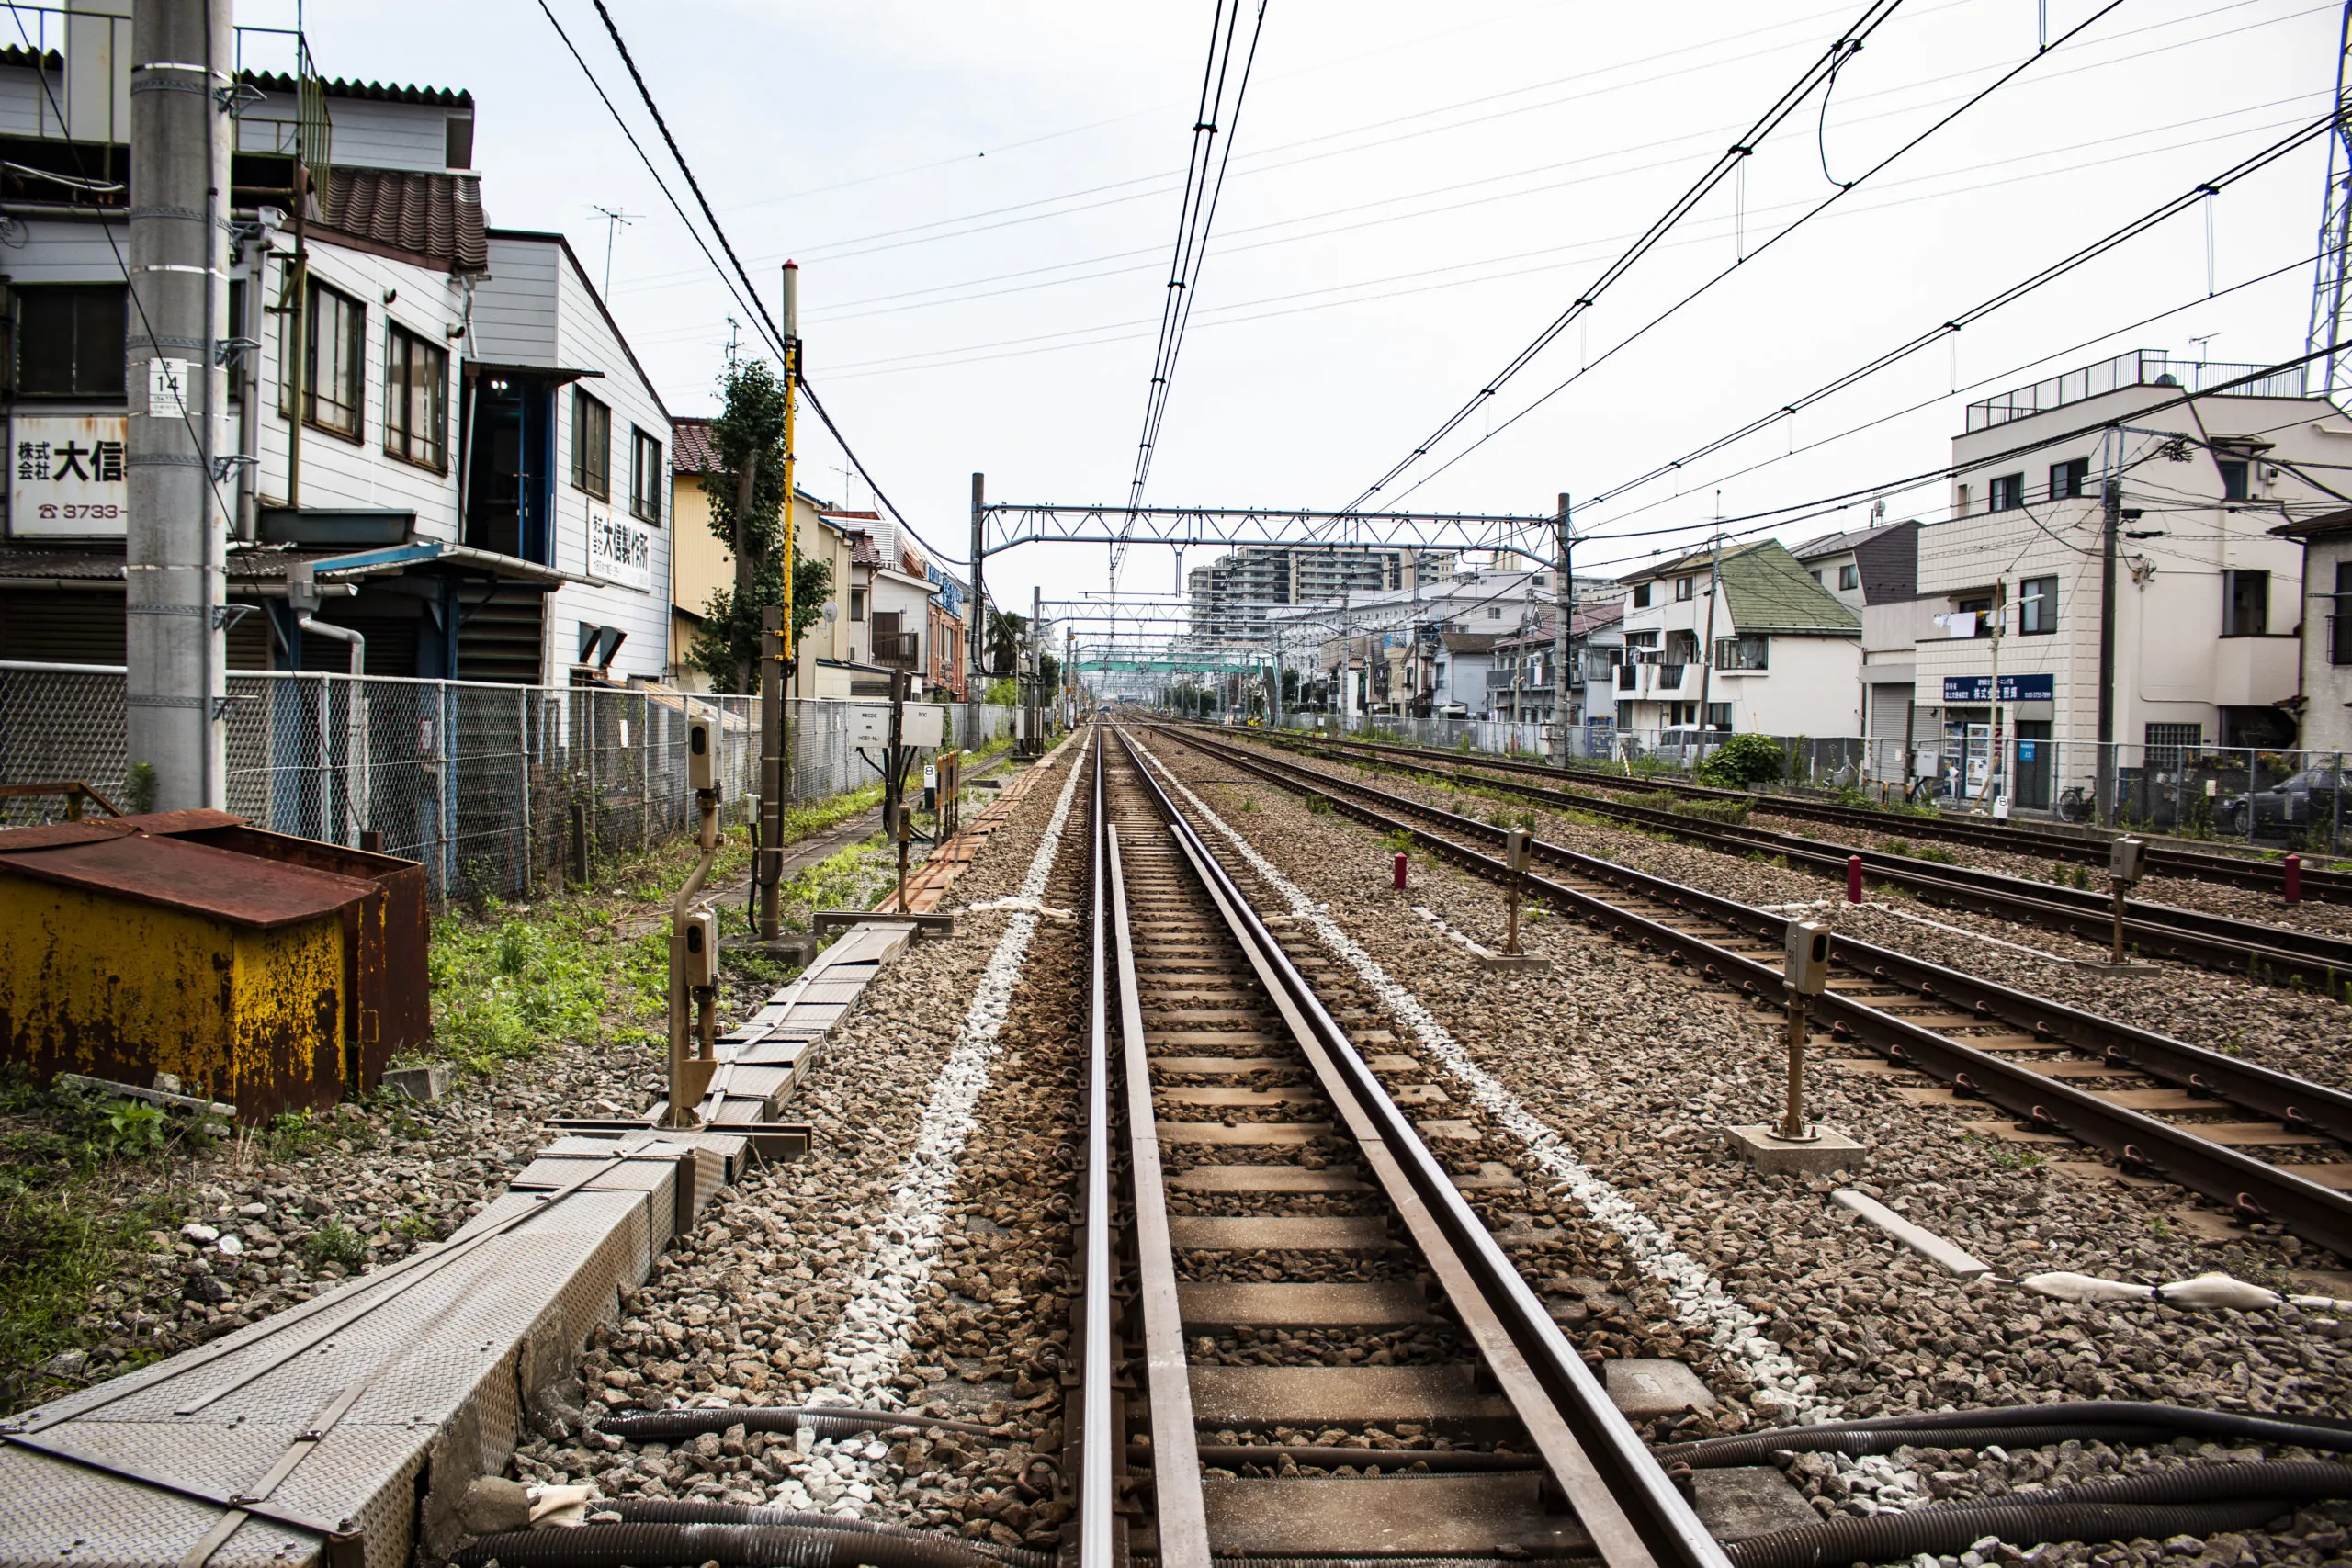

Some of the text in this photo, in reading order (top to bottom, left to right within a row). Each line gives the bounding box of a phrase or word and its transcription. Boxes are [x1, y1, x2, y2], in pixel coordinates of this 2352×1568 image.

[157, 375, 179, 392] 14
[53, 441, 128, 482] 大信
[604, 518, 649, 571] 大信製作所
[925, 766, 933, 775] 8
[1998, 797, 2007, 807] 8
